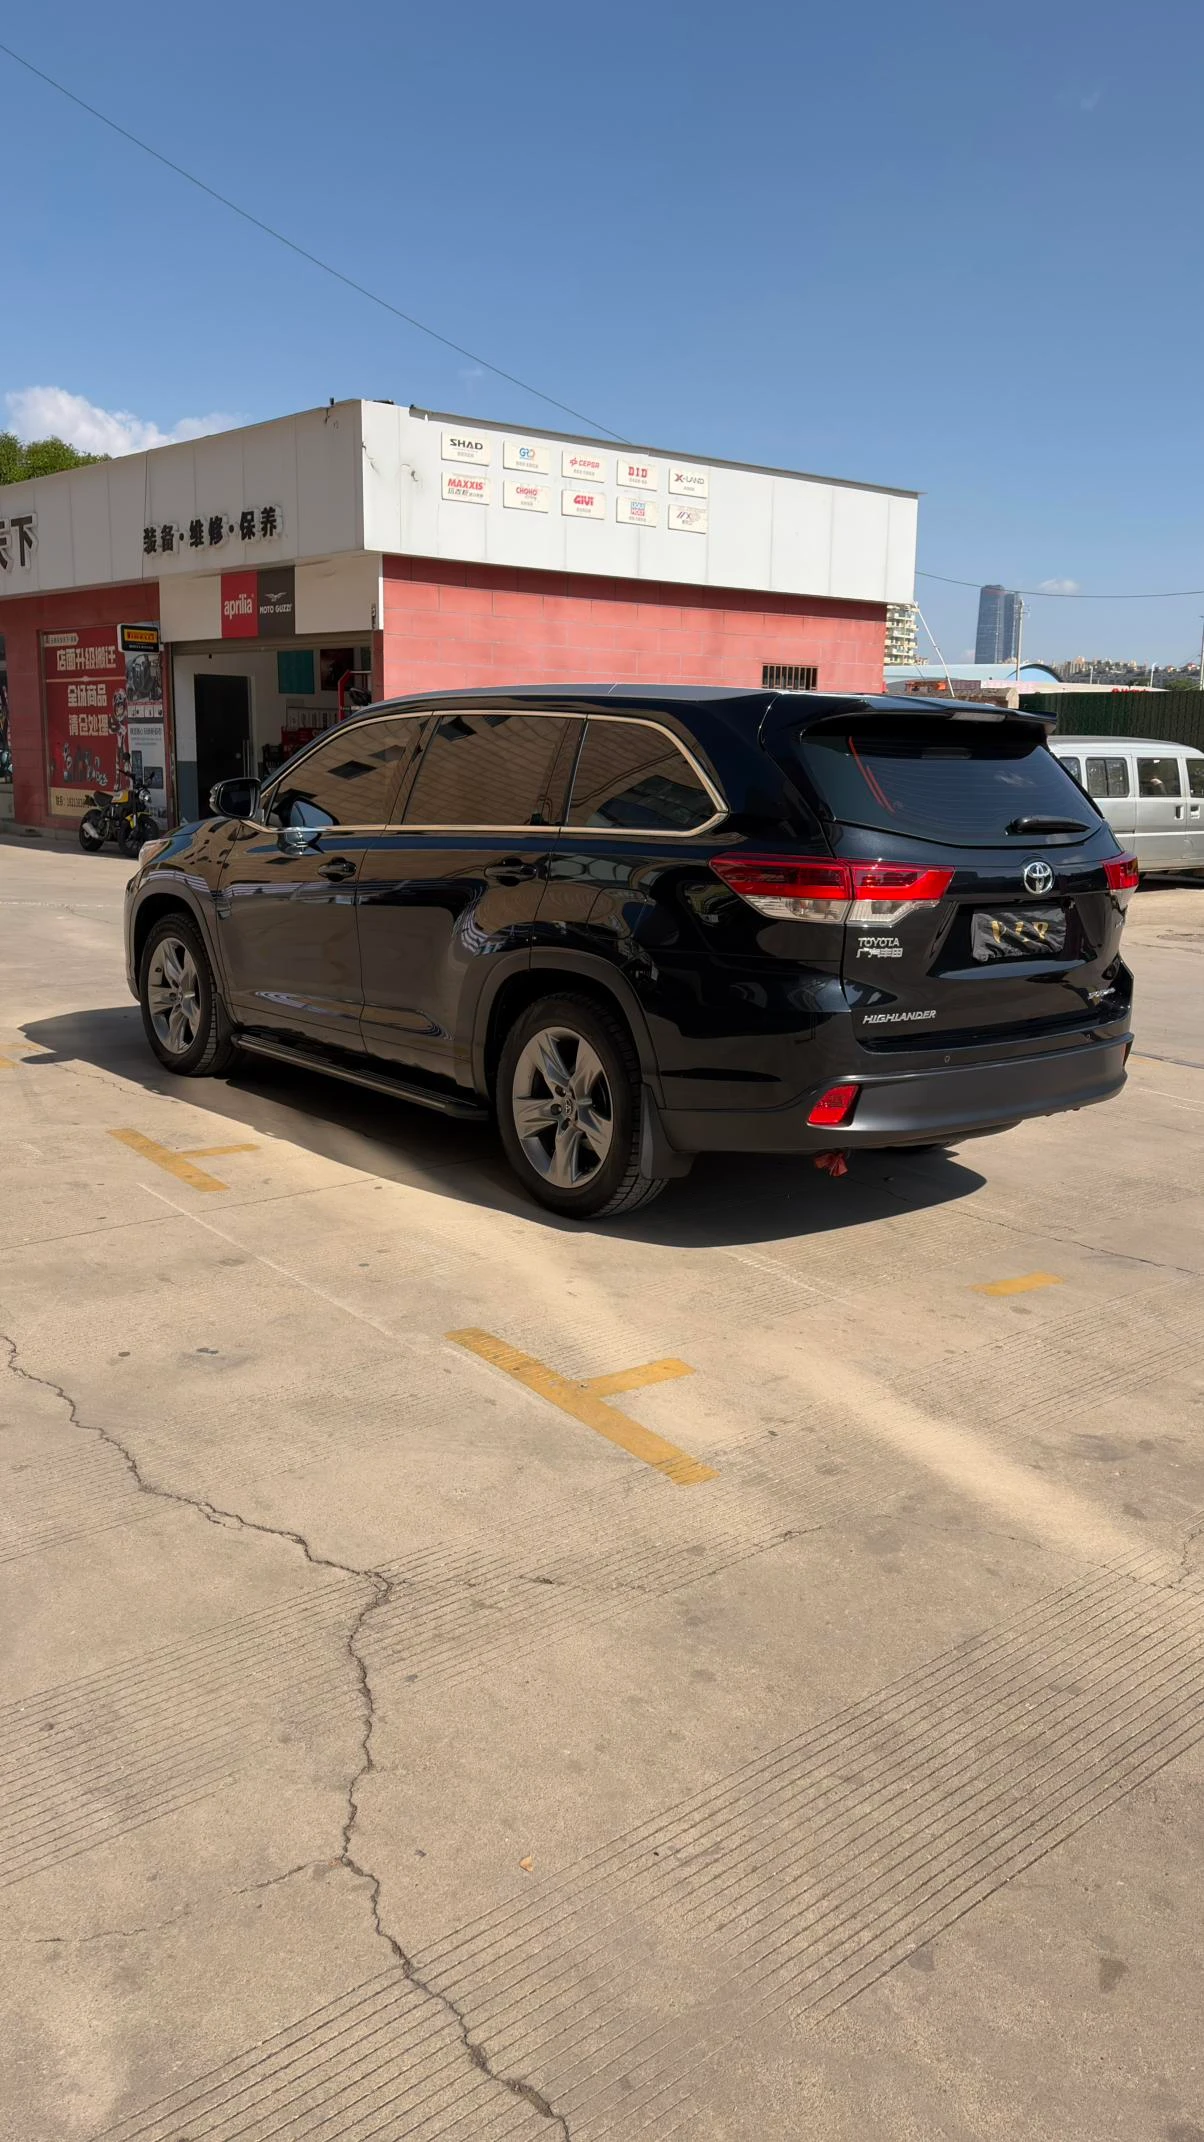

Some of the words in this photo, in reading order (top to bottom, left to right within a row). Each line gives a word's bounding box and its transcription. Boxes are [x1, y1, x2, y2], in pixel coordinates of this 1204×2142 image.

[449, 438, 484, 451] SHAD
[628, 466, 648, 479] DID
[447, 478, 485, 491] MAXXIS
[573, 494, 594, 507] GIVI
[224, 593, 253, 620] aprilia
[259, 605, 274, 614] MOTO
[67, 683, 108, 707] 全场商品
[68, 714, 109, 736] 清仓处理
[858, 937, 900, 947] TOYOTA
[862, 1010, 937, 1024] HIGHLANDER
